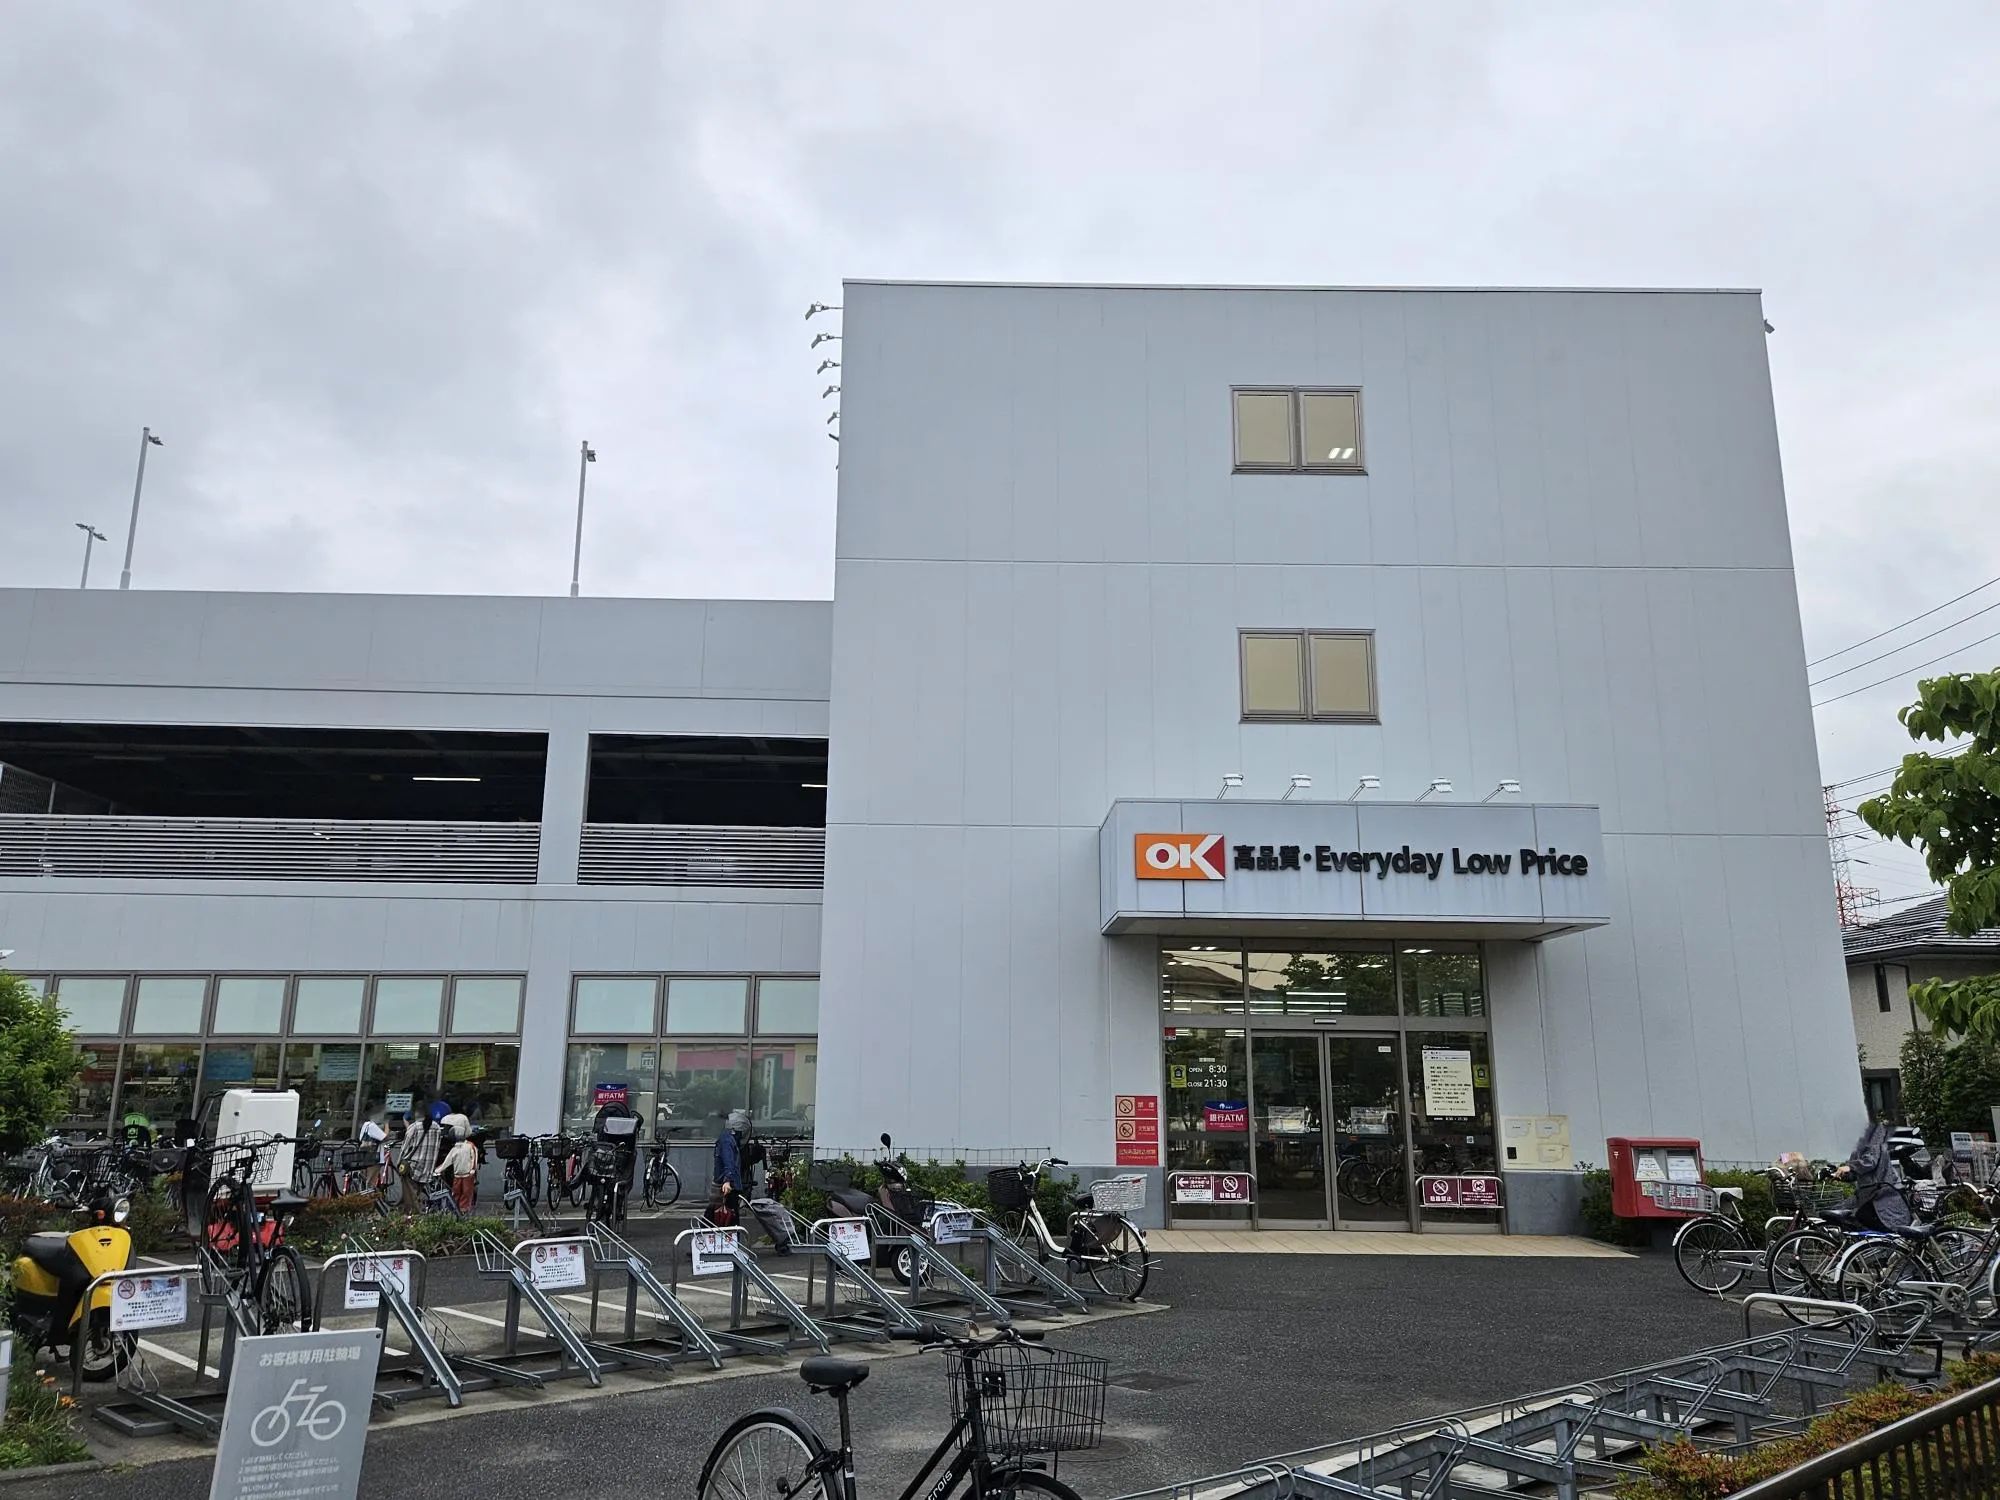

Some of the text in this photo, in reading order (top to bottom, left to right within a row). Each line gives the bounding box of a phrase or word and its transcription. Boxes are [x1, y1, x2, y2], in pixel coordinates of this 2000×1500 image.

[1144, 834, 1225, 880] OK
[1453, 847, 1511, 875] Low
[1521, 848, 1588, 876] Price
[1208, 1064, 1227, 1073] 8:30
[1203, 1079, 1228, 1088] 21:30
[1209, 1113, 1244, 1122] 銀行ATM
